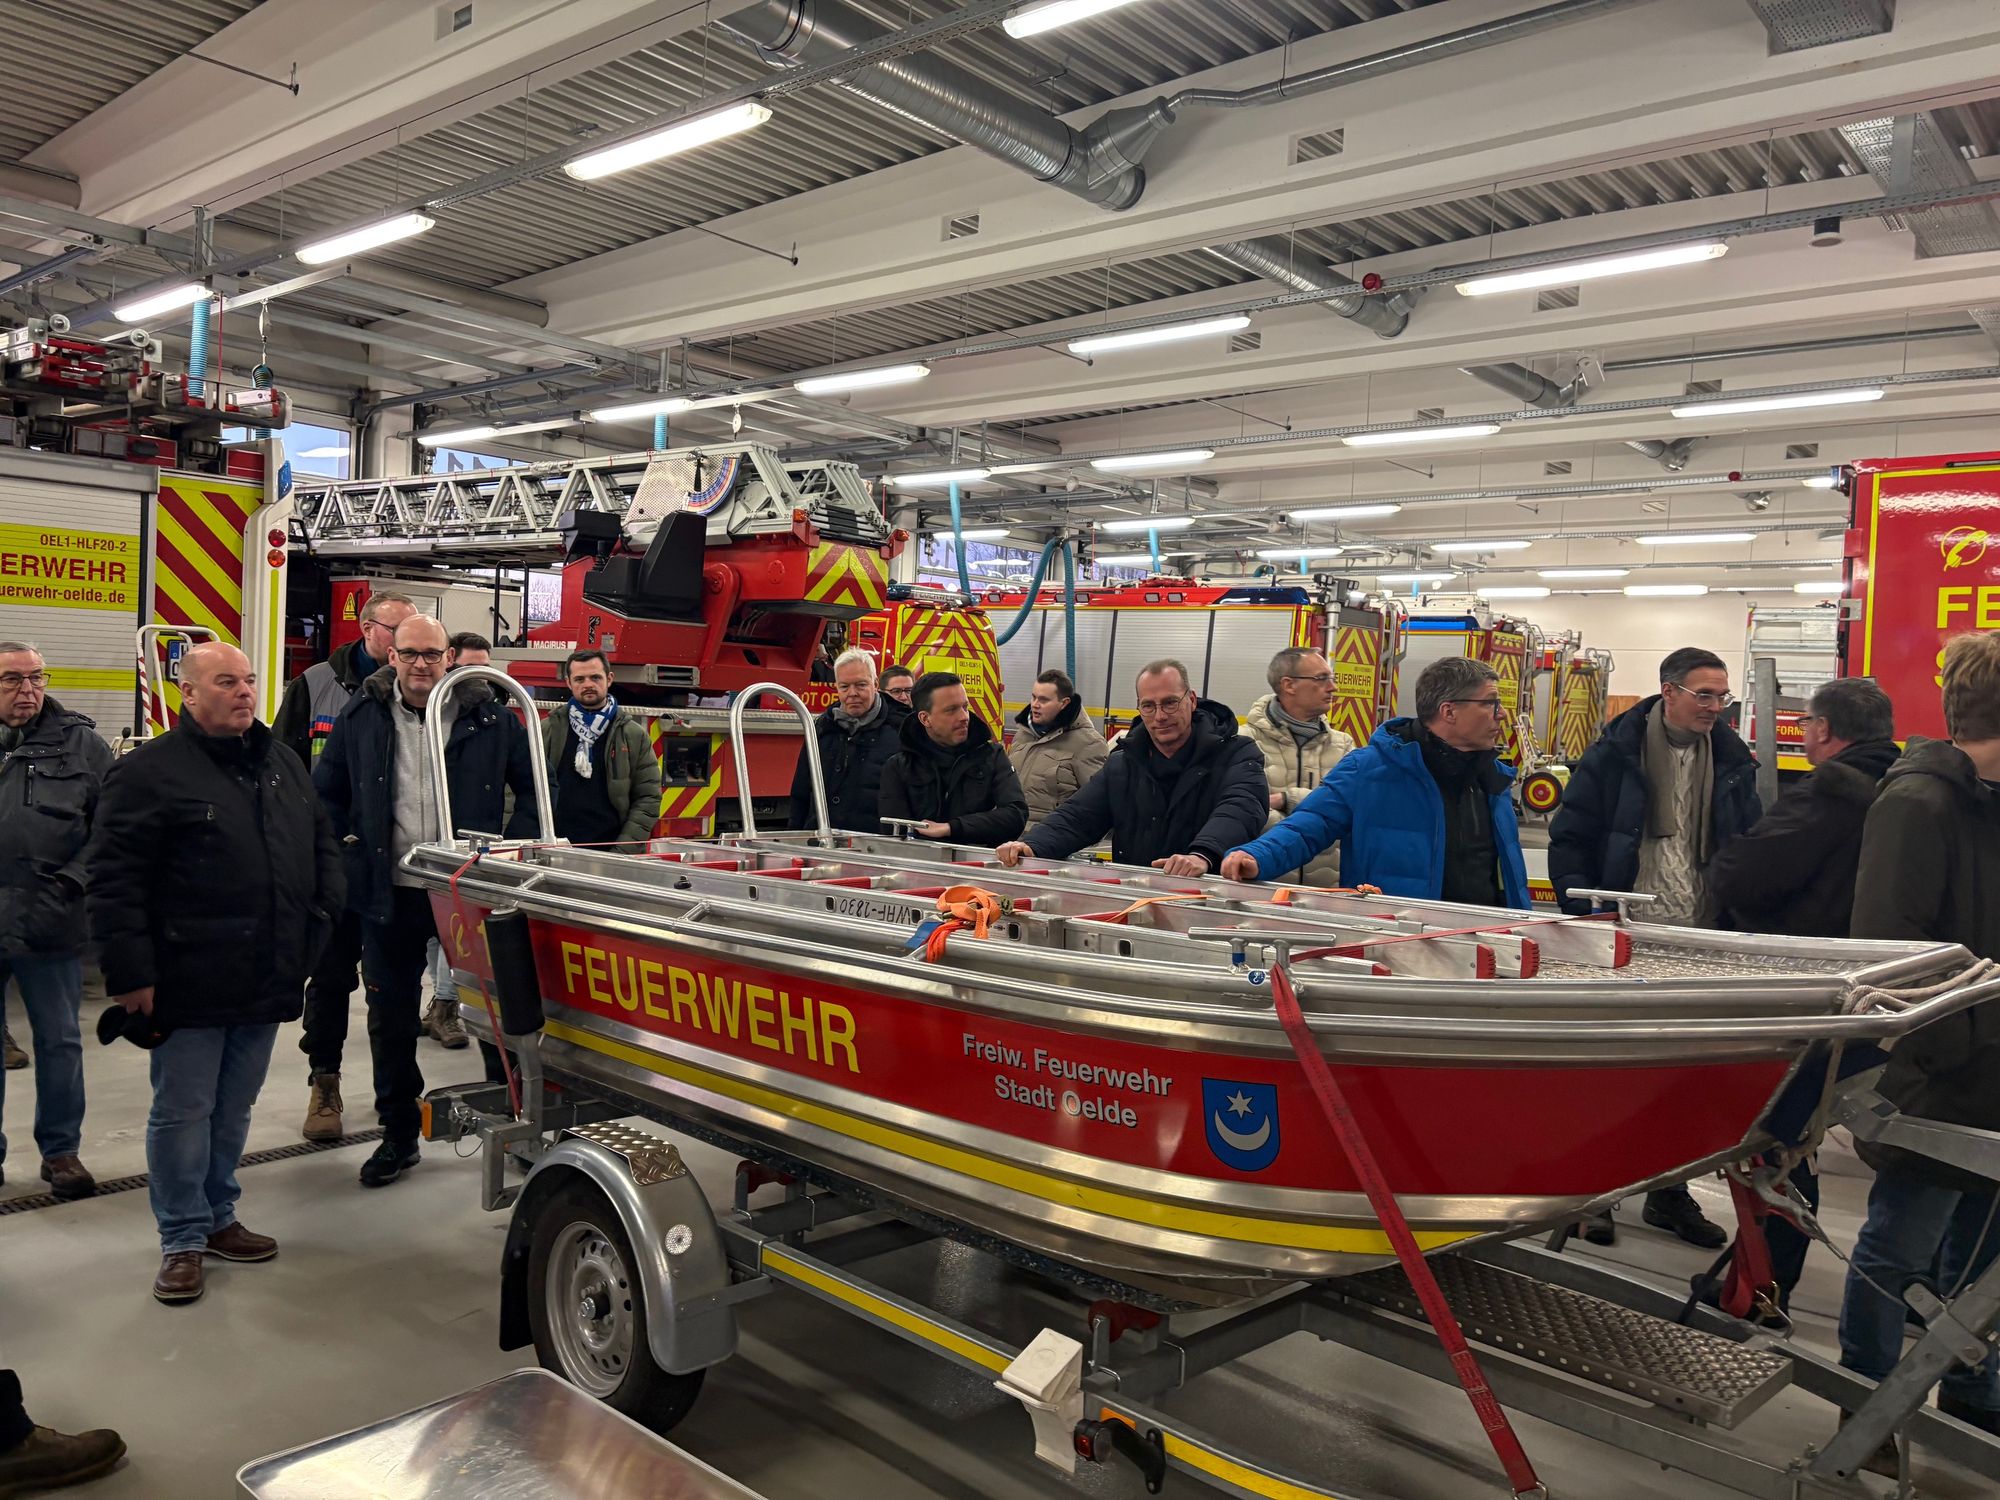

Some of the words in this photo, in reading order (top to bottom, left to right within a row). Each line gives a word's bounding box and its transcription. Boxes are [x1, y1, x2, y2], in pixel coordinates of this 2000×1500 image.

[40, 533, 127, 553] OEL1-HLF20-2
[1, 552, 127, 584] ERWEHR
[1937, 585, 2000, 629] FE
[533, 640, 567, 650] MAGIRUS
[560, 940, 861, 1074] FEUERWEHR
[963, 1032, 1028, 1071] Freiw.
[1034, 1047, 1174, 1097] Feuerwehr
[994, 1074, 1057, 1112] Stadt
[1061, 1090, 1138, 1128] Oelde
